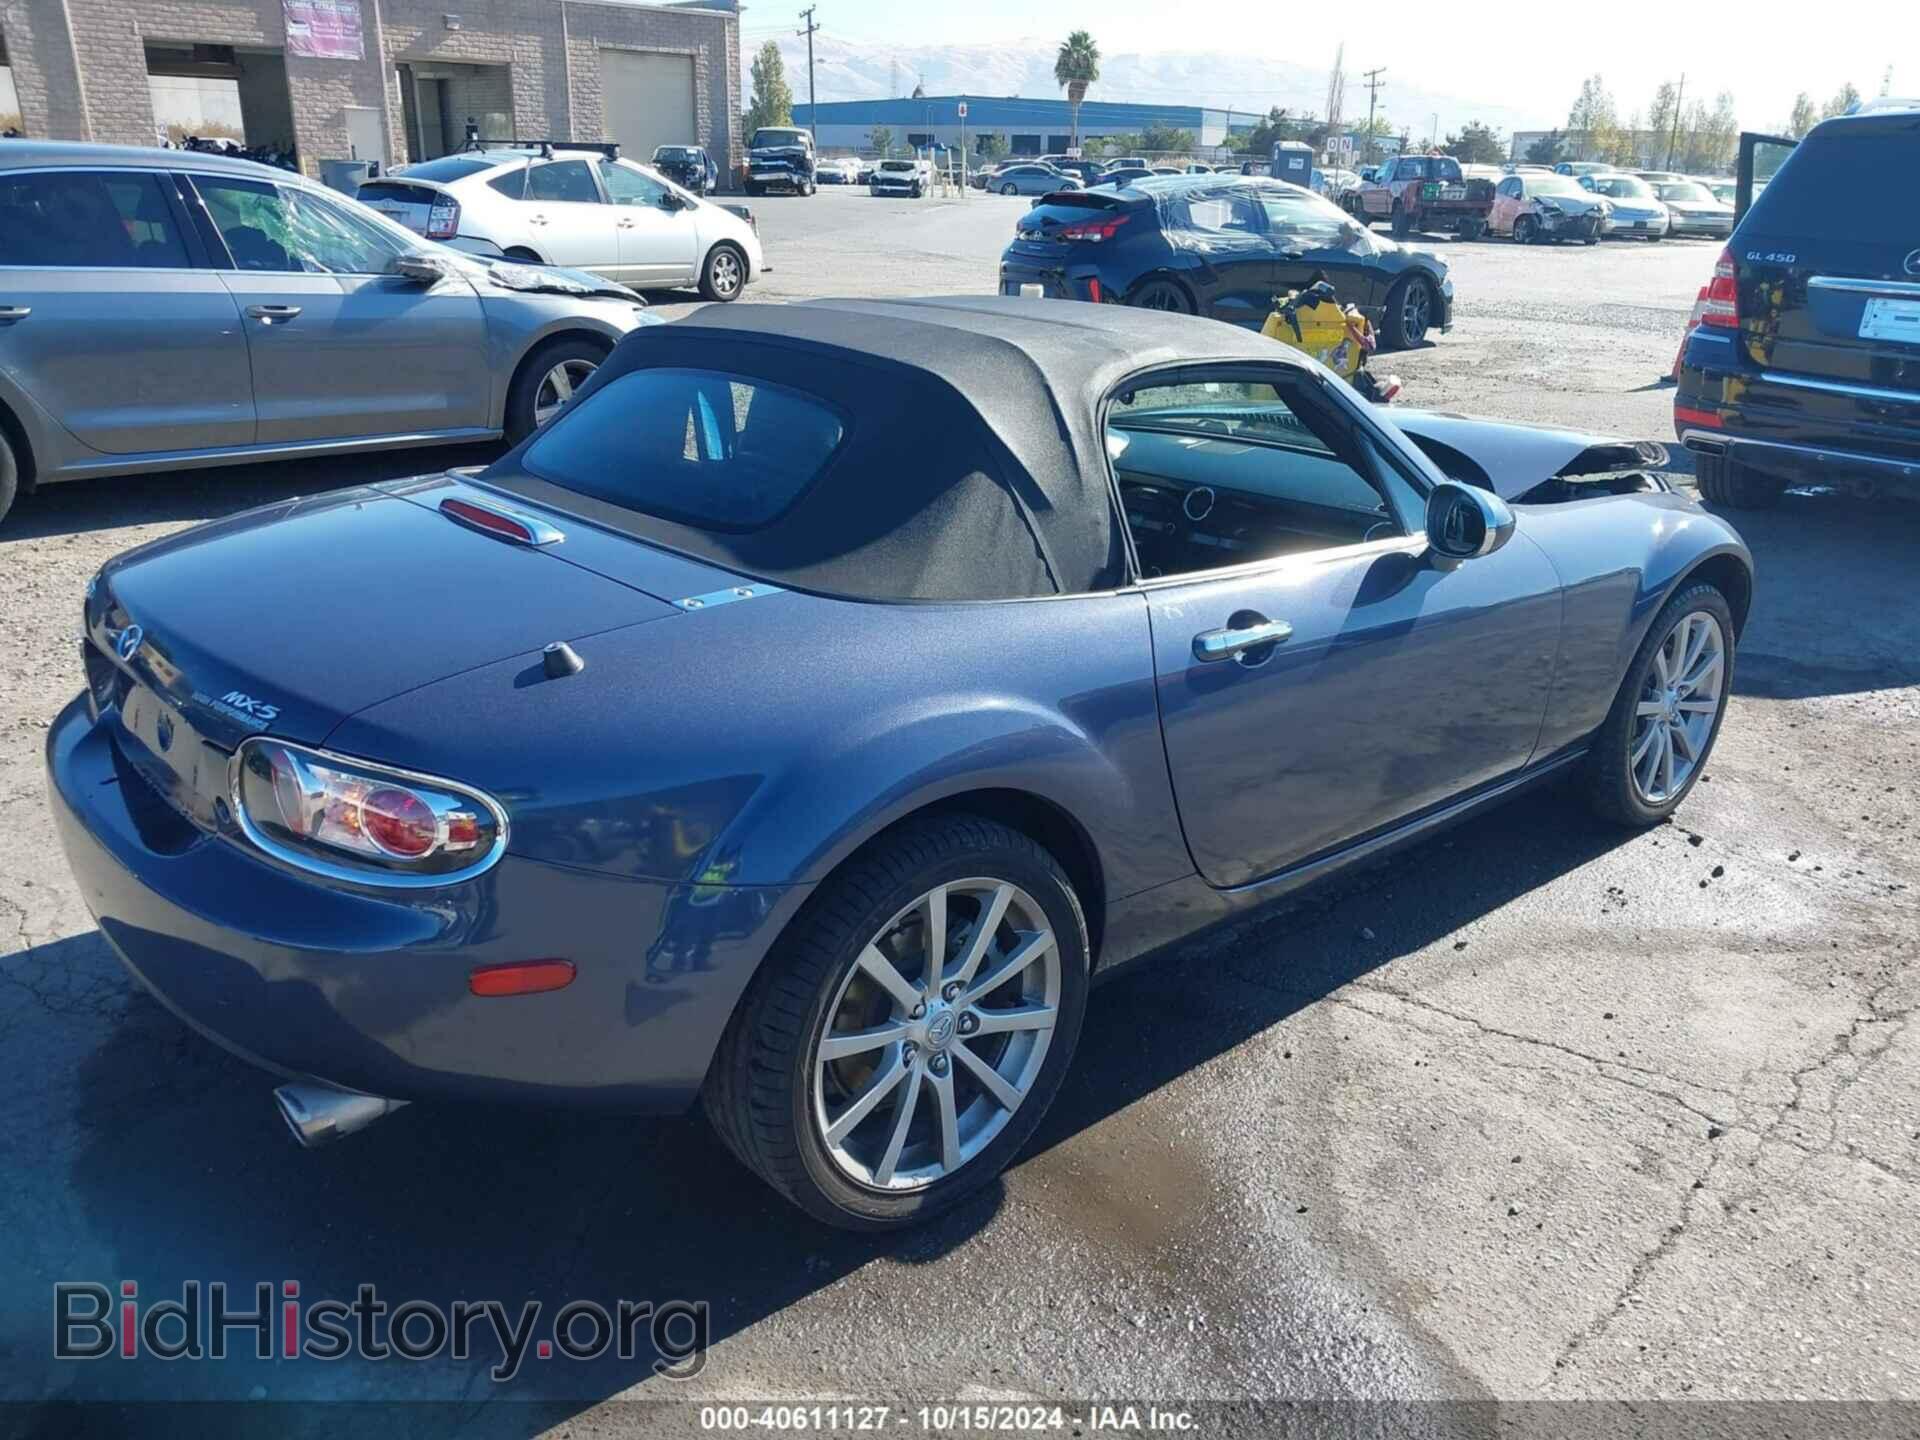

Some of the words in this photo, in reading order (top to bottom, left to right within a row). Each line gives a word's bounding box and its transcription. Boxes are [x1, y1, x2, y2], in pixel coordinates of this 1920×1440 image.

[1746, 251, 1761, 260] GL
[1765, 252, 1796, 262] 450
[221, 691, 281, 719] MX-5
